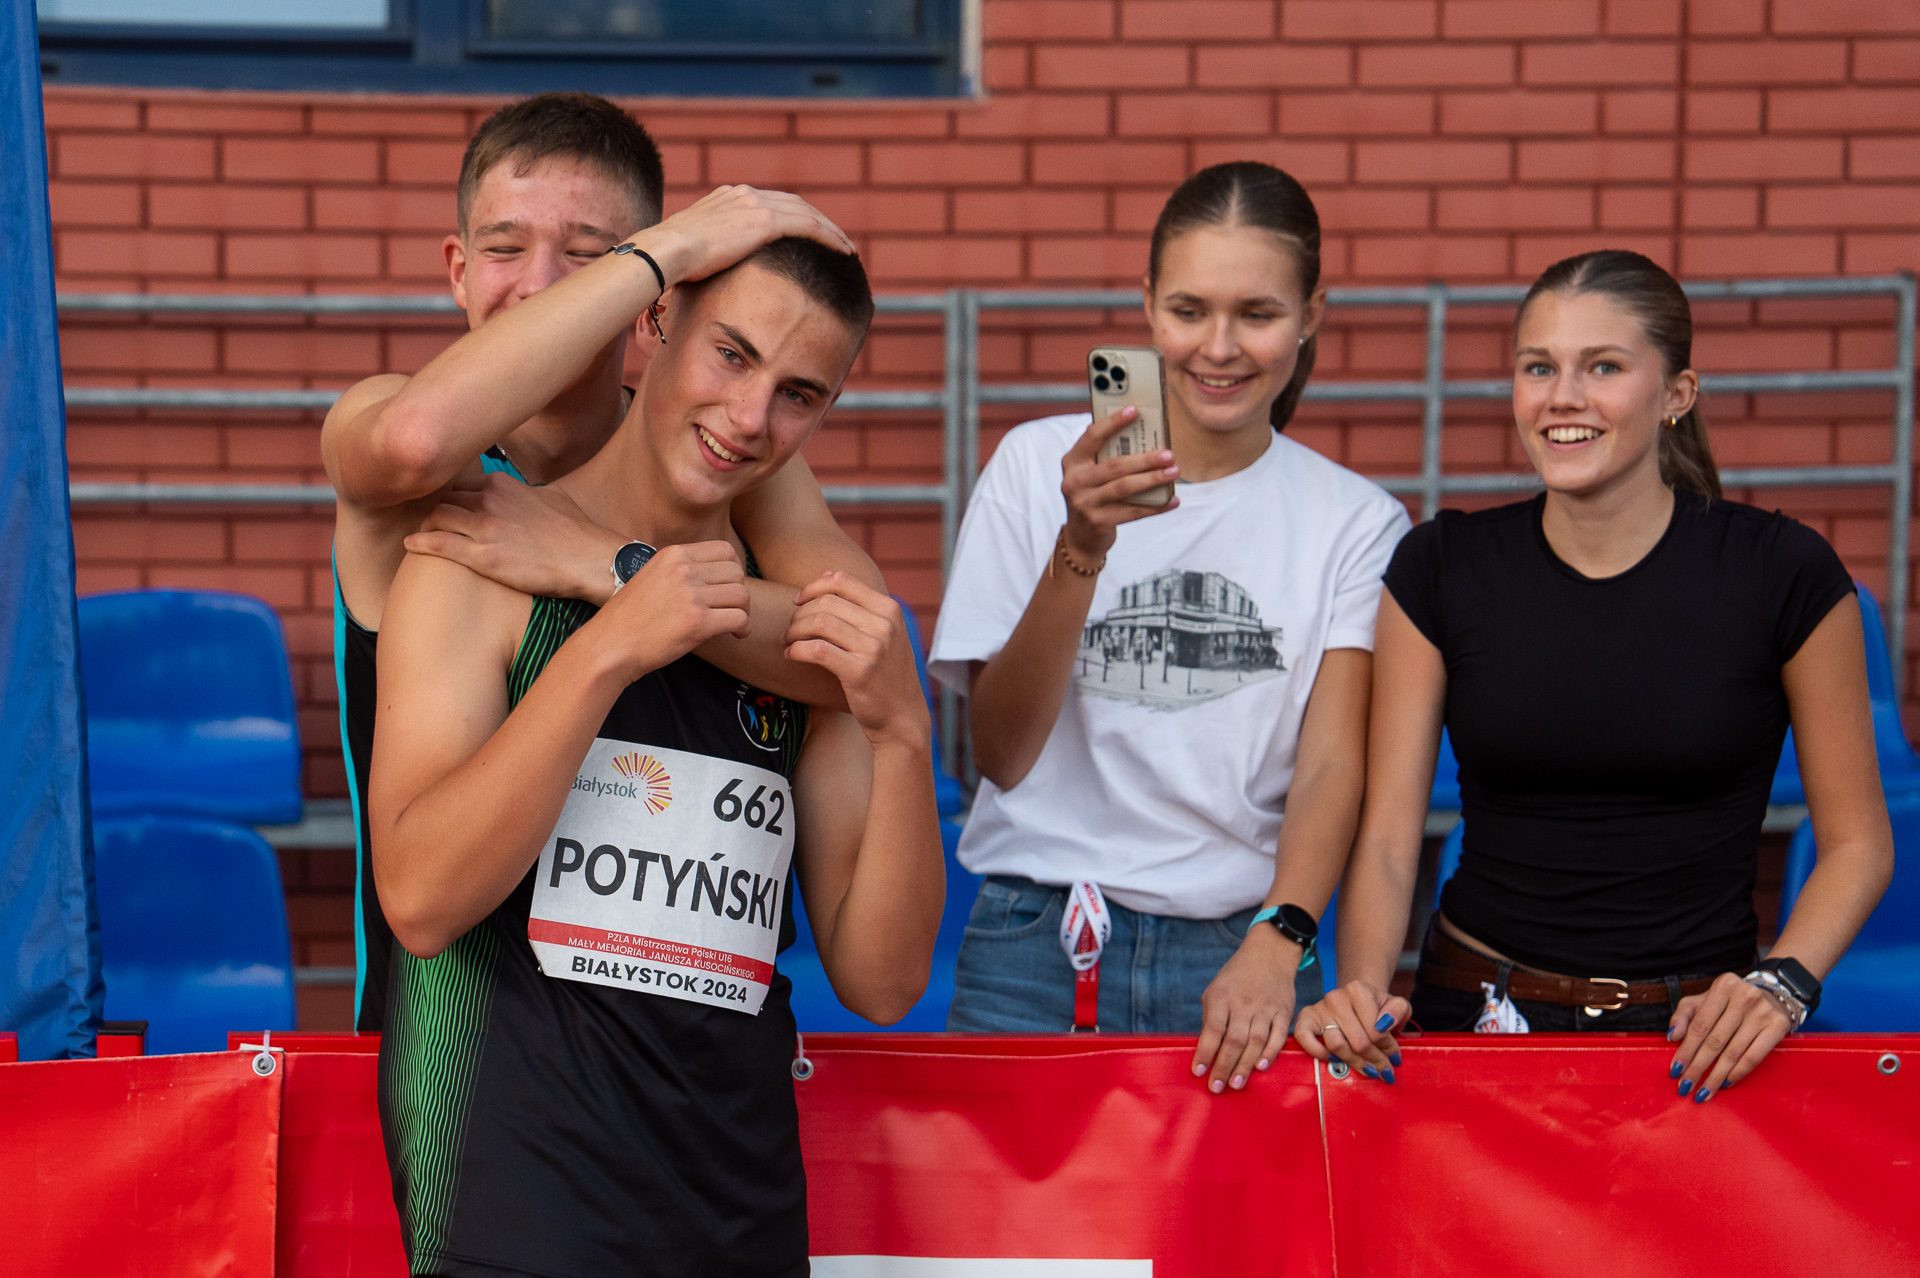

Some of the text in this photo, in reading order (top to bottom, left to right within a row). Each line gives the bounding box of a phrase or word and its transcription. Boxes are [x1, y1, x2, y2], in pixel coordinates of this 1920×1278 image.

[713, 778, 786, 836] 662
[549, 837, 779, 930] POTYŃSKI
[568, 937, 755, 980] MAŁY MEMORIAŁ JANUSZA KUSOCIŃSKIEGO
[607, 932, 733, 964] PZLA Mistrzostwa Polski U16
[571, 955, 748, 1003] BIAŁYSTOK 2024
